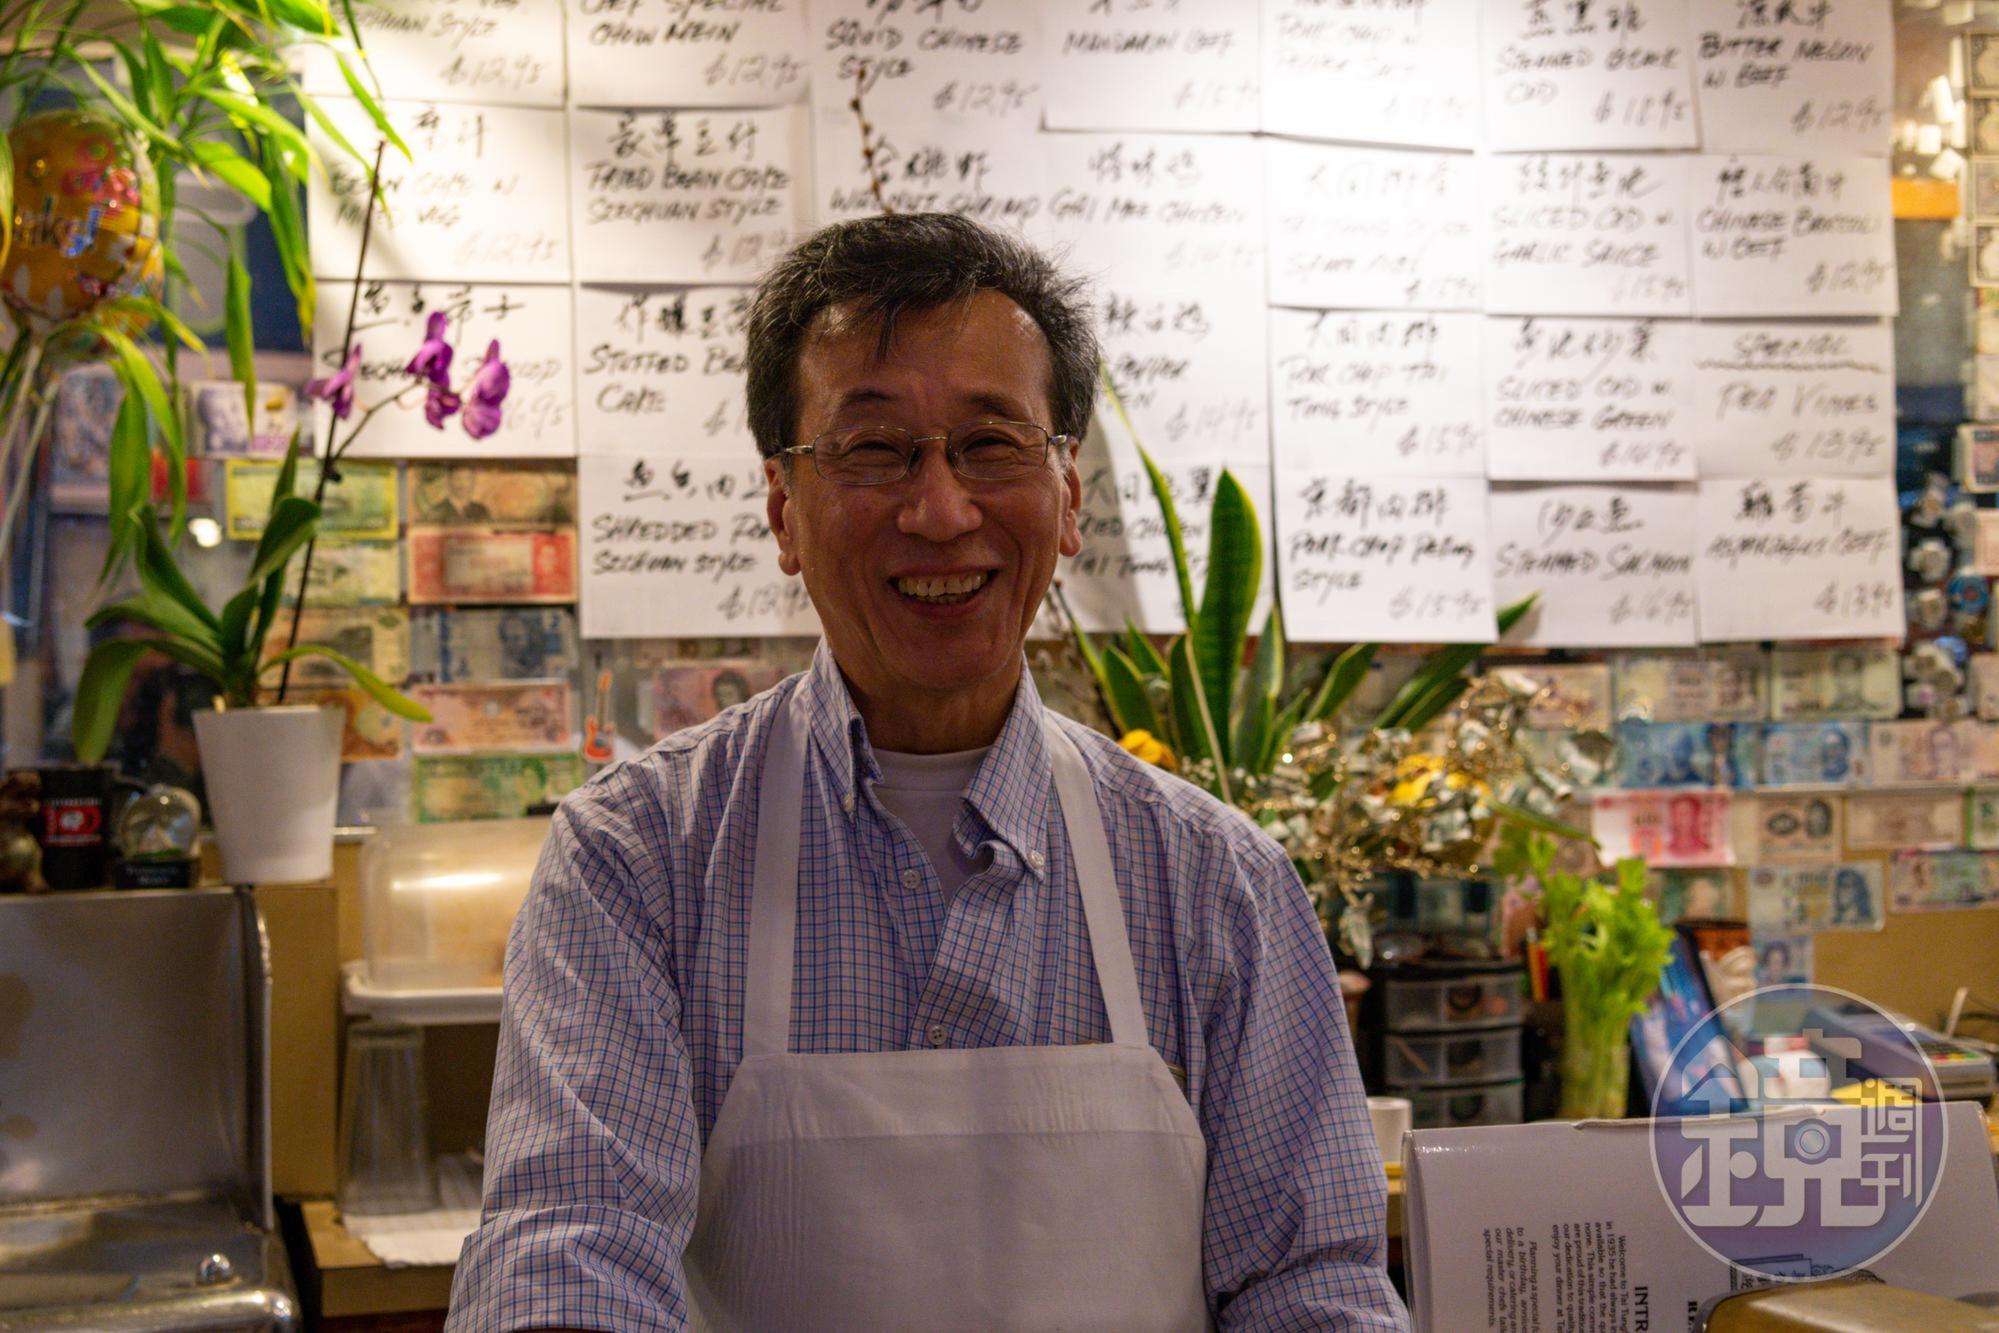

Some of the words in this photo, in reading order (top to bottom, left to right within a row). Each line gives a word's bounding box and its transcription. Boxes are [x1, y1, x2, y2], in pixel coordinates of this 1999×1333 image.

[1516, 1227, 1525, 1237] to
[1574, 1223, 1582, 1239] are
[1606, 1221, 1613, 1230] in
[1482, 1229, 1494, 1262] special
[1495, 1228, 1503, 1244] our
[1552, 1224, 1561, 1250] enjoy
[1595, 1222, 1606, 1264] available
[1607, 1233, 1616, 1257] 1935
[1529, 1241, 1539, 1284] Planning
[1552, 1252, 1561, 1274] your
[1574, 1240, 1584, 1268] proud
[1587, 1252, 1595, 1271] This
[1618, 1235, 1626, 1278] Welcome
[1497, 1249, 1506, 1282] master
[1565, 1241, 1574, 1290] dedication
[1578, 1268, 1585, 1278] of
[1599, 1267, 1605, 1278] so
[1609, 1259, 1616, 1270] he
[1510, 1270, 1516, 1280] or
[1610, 1272, 1618, 1290] had
[1556, 1276, 1564, 1306] dinner
[1578, 1280, 1586, 1297] this
[1587, 1273, 1596, 1305] simple
[1599, 1281, 1607, 1300] that
[1621, 1280, 1628, 1290] to
[1508, 1282, 1518, 1320] catering
[1568, 1292, 1575, 1302] to
[1530, 1292, 1540, 1325] special
[1557, 1308, 1564, 1318] at
[1600, 1303, 1608, 1319] the
[1608, 1292, 1618, 1324] always
